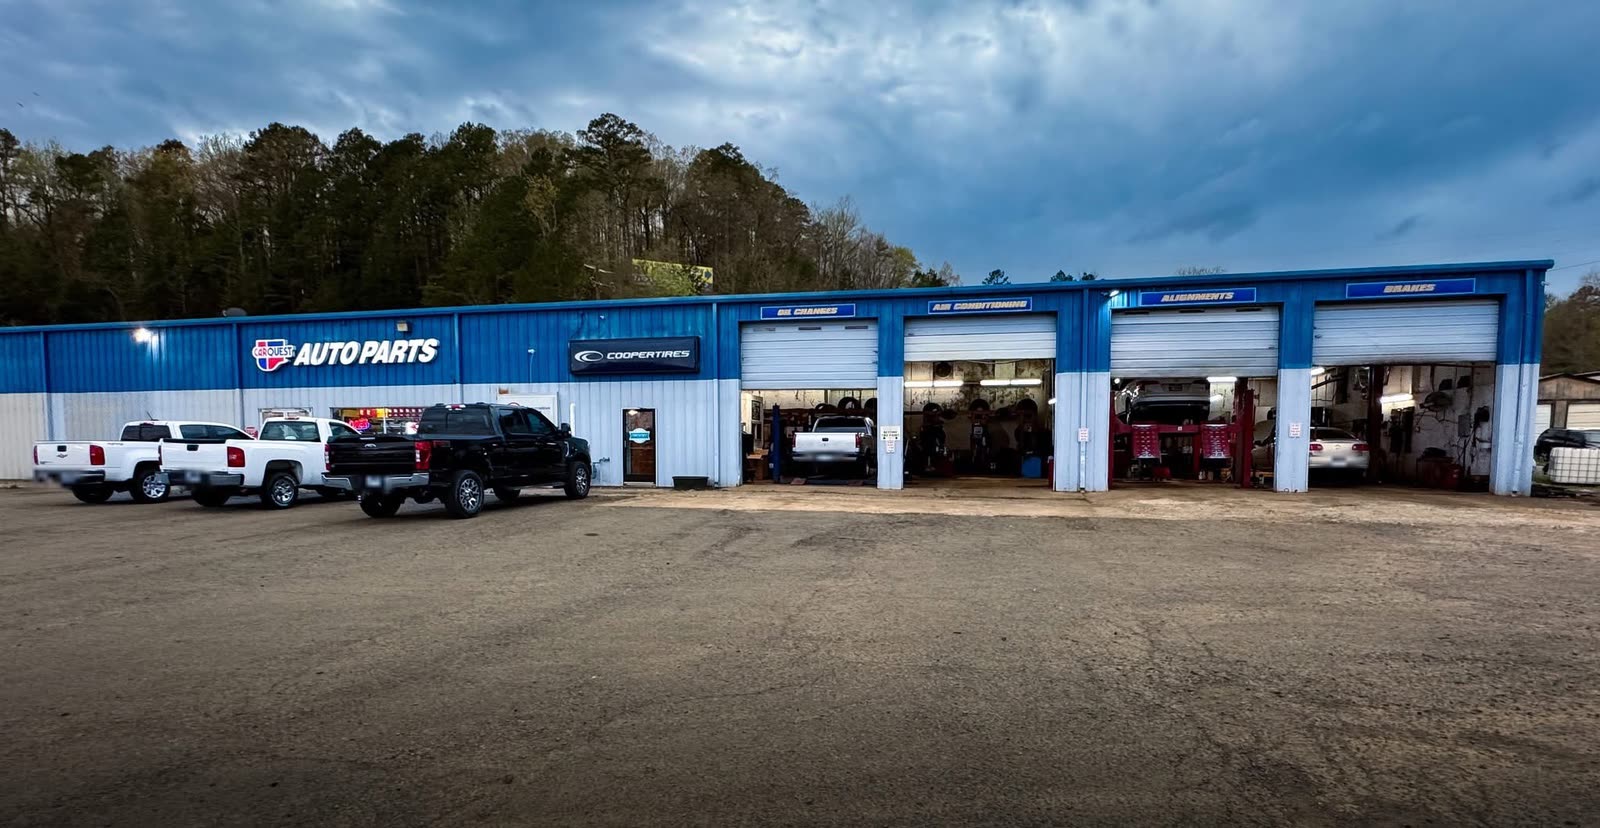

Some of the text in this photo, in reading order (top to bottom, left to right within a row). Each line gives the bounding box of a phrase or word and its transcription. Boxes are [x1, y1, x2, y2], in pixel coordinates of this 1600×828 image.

[1383, 283, 1437, 294] BRAKES
[1161, 291, 1235, 303] ALIGNMENTS
[932, 300, 1028, 311] AIR CONDITIONING
[777, 307, 838, 316] OIL CHANGES
[254, 346, 293, 357] CARQUEST
[293, 338, 439, 366] AUTO PARTS
